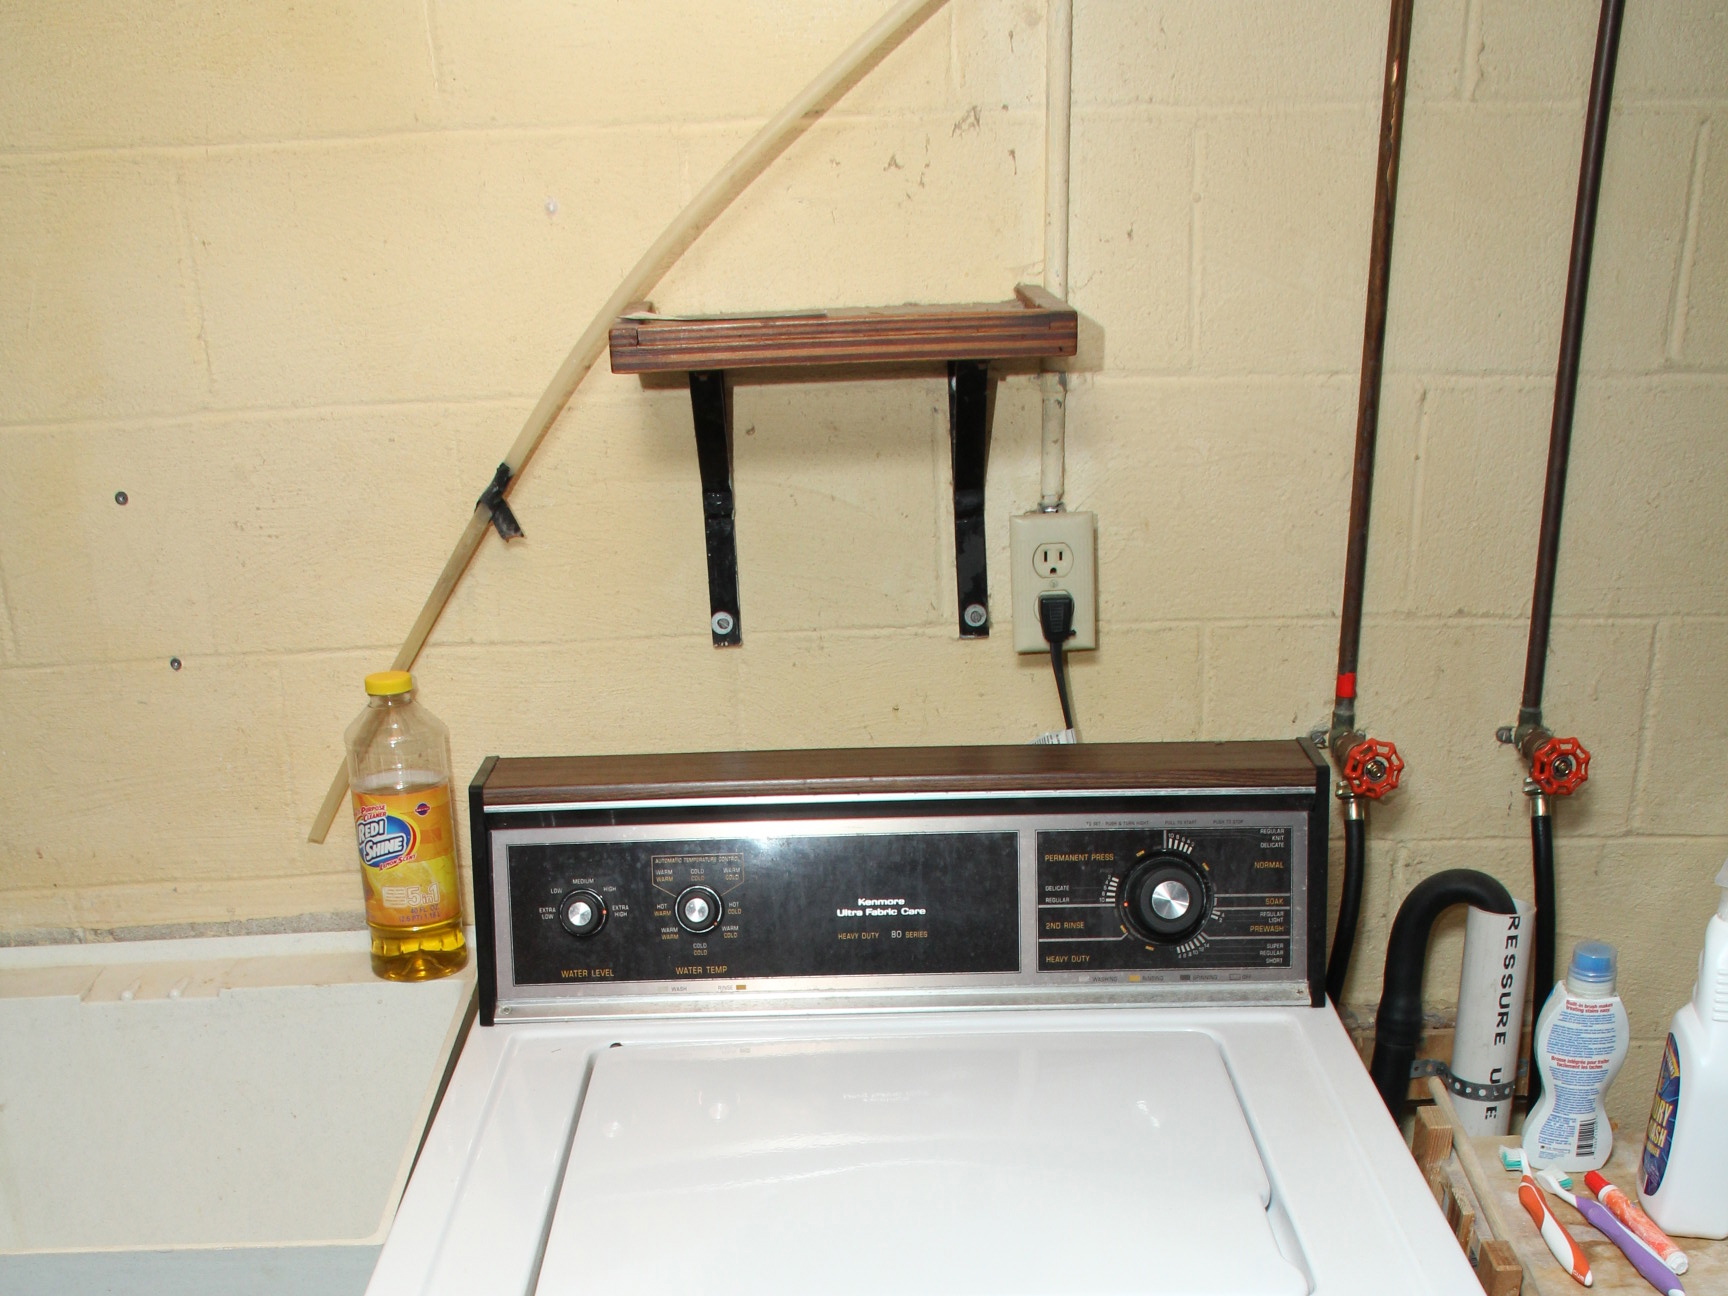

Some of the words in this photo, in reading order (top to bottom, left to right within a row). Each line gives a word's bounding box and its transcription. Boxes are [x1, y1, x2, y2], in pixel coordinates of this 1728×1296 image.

[358, 819, 385, 844] REDI
[365, 836, 403, 861] SHINE
[1045, 854, 1088, 862] PERMANENT
[1091, 853, 1114, 861] PRESS
[1254, 861, 1284, 869] NORMAL
[858, 897, 905, 906] Kenmore
[836, 908, 863, 917] Ultra
[865, 907, 898, 916] Fabric
[901, 906, 926, 916] Care
[1045, 922, 1061, 930] 2ND
[1063, 921, 1085, 929] RINSE
[838, 932, 859, 940] HEAVY
[861, 931, 879, 940] DUTY
[905, 930, 928, 939] SERIES
[1045, 955, 1068, 963] HEAVY
[561, 969, 588, 978] WATER
[591, 968, 614, 977] LEVEL
[675, 966, 703, 975] WATER
[706, 965, 728, 974] TEMP
[1494, 916, 1521, 1046] RESSURE
[1485, 1067, 1502, 1120] UE
